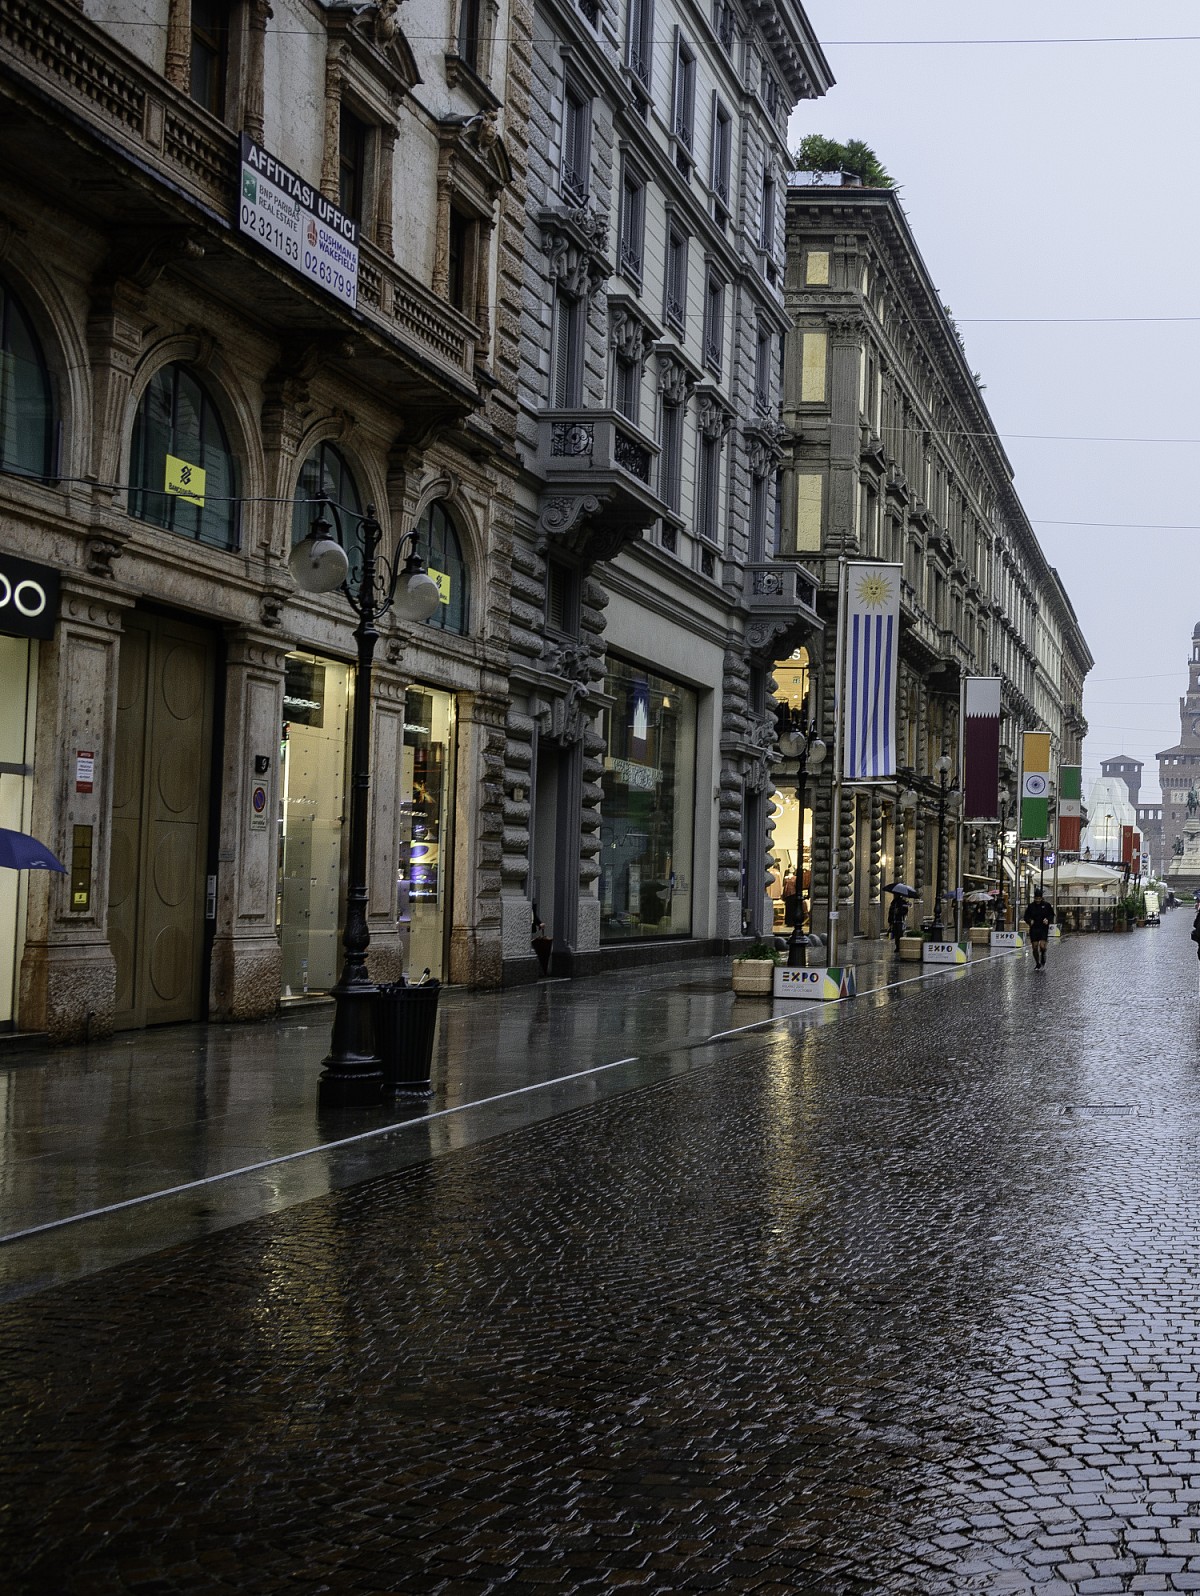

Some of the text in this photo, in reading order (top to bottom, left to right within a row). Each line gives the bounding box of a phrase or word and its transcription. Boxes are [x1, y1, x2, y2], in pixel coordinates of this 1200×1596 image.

[248, 145, 356, 241] AFFITTASI UFFICI
[259, 185, 300, 222] BNP PARIBAS
[258, 199, 298, 232] REAL ESTATE
[319, 229, 352, 262] CUSHMAN
[319, 241, 355, 273] WAKEFIELD
[928, 944, 953, 953] EXPO
[782, 971, 820, 983] EXPO
